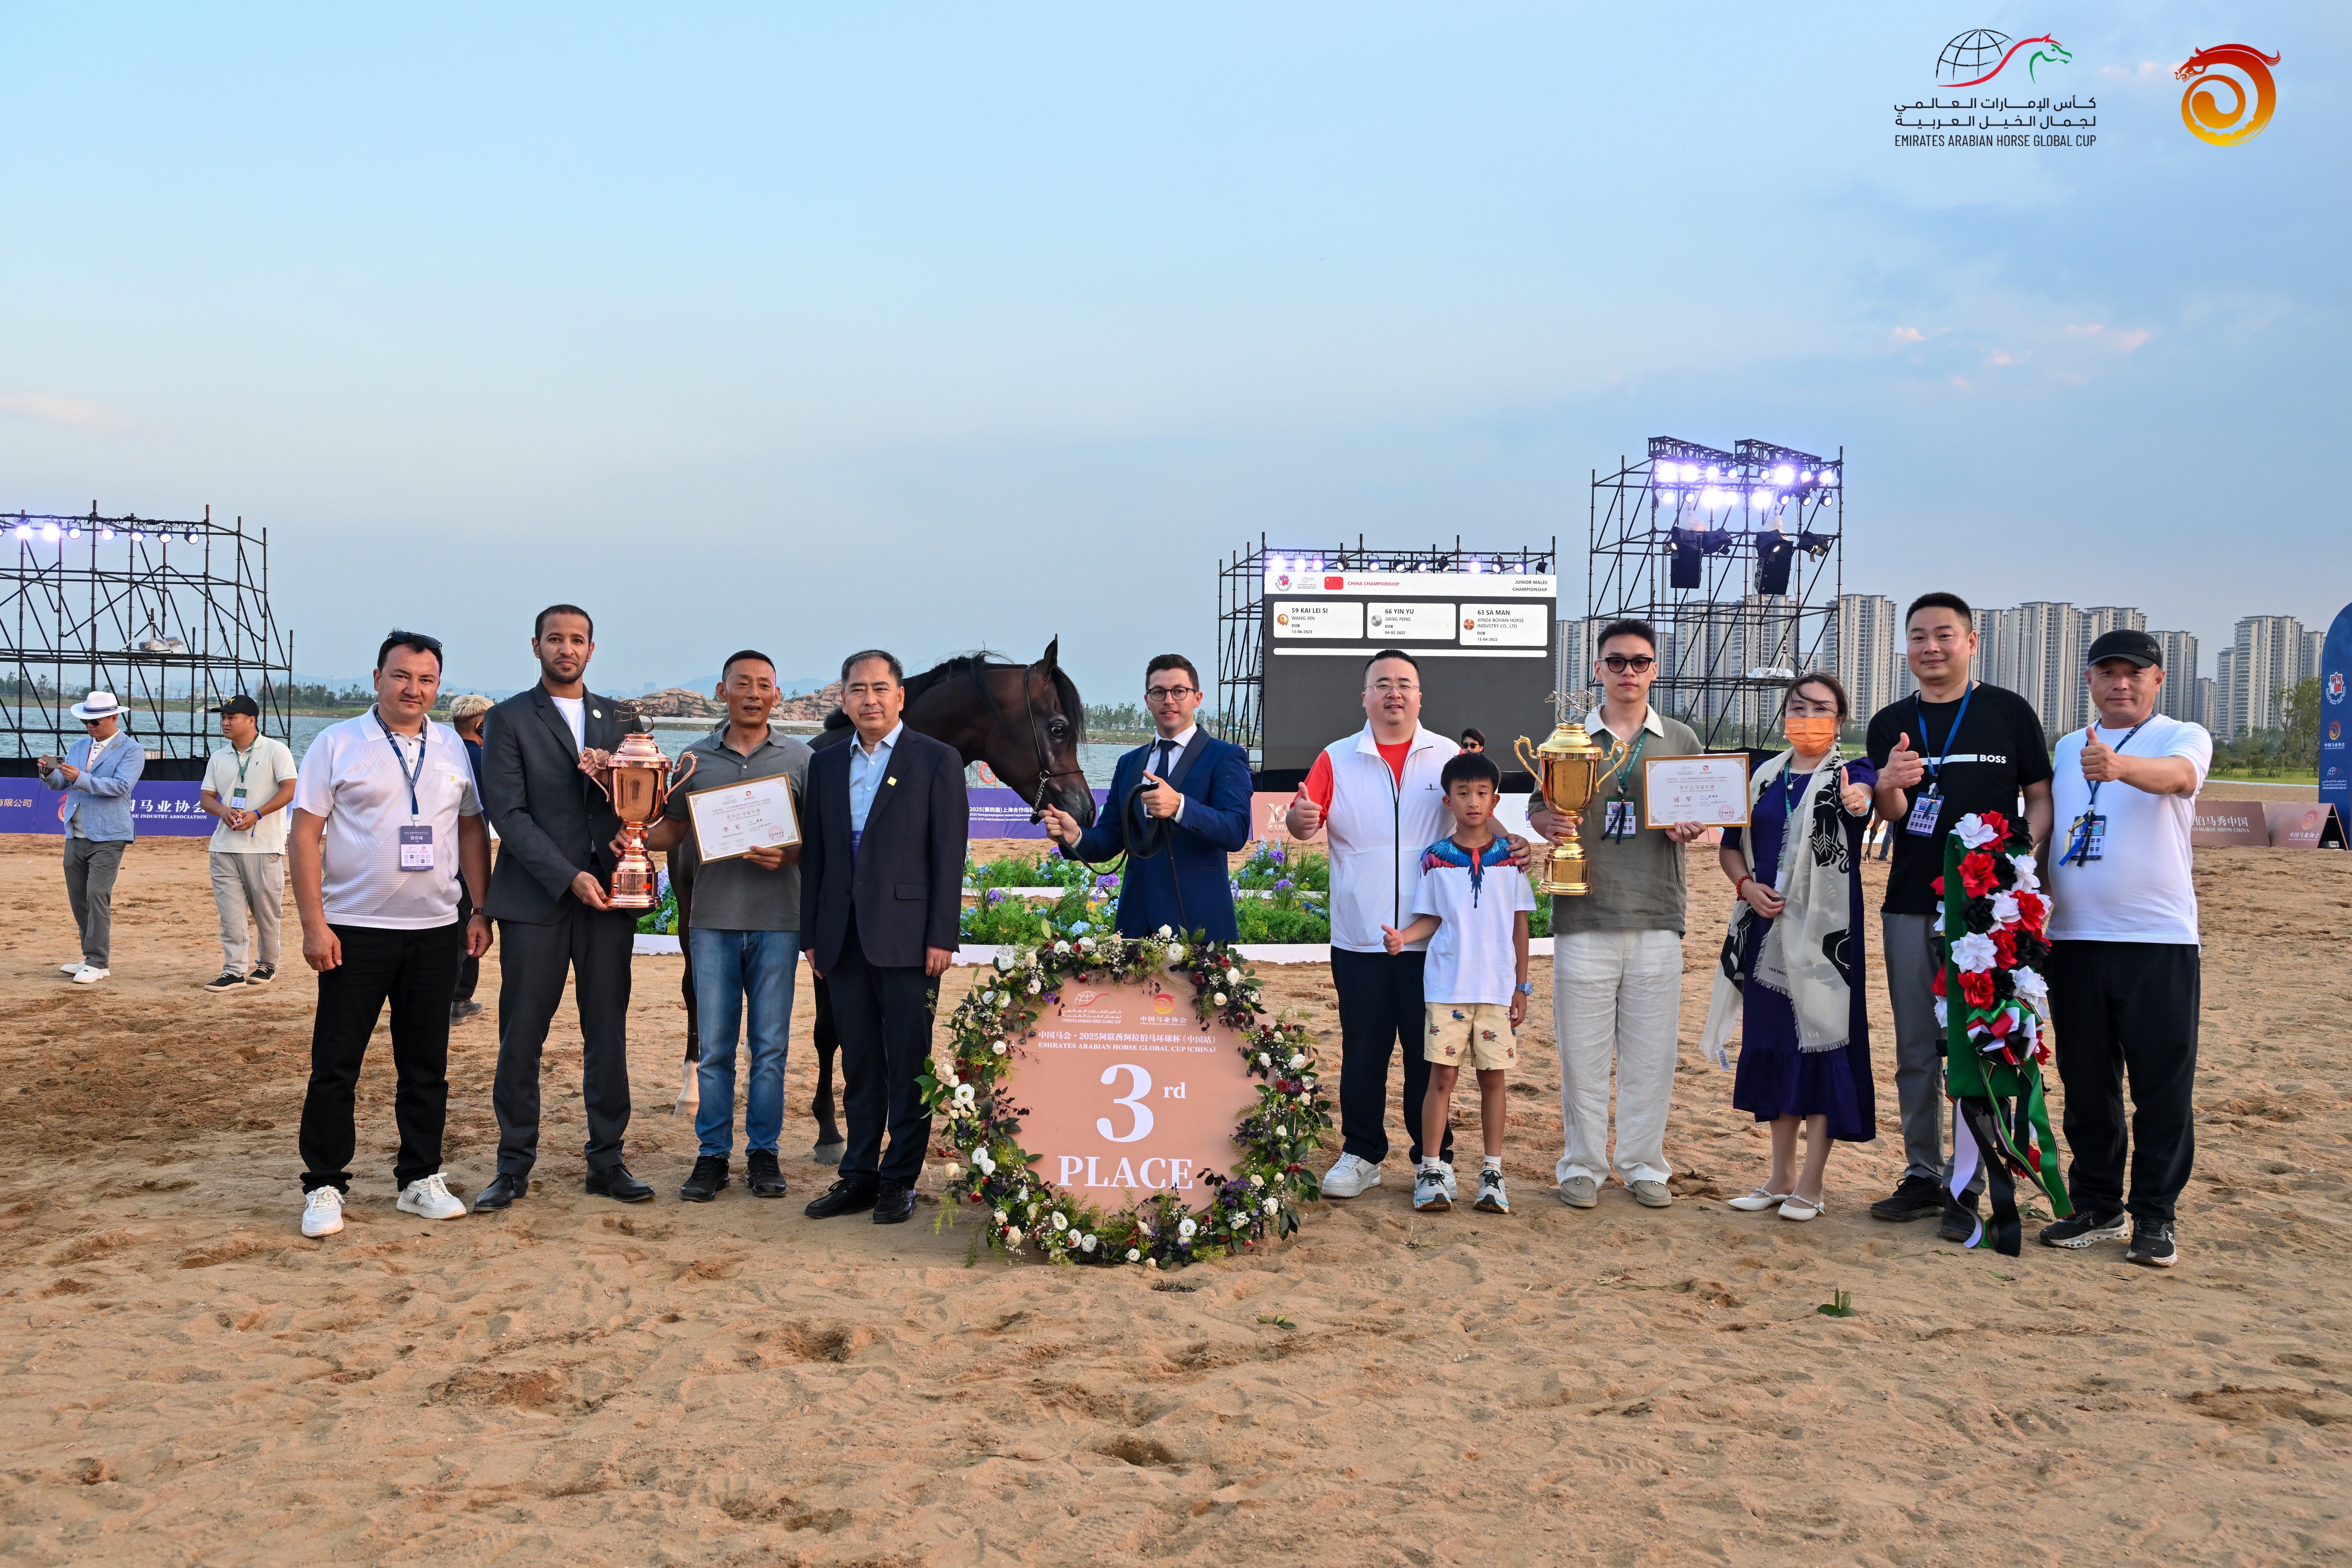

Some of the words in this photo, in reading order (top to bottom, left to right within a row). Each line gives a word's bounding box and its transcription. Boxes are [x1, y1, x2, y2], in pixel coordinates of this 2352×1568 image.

[1980, 754, 2006, 763] BOSS
[727, 808, 760, 819] 青年公马冠军赛
[1057, 1155, 1192, 1189] PLACE
